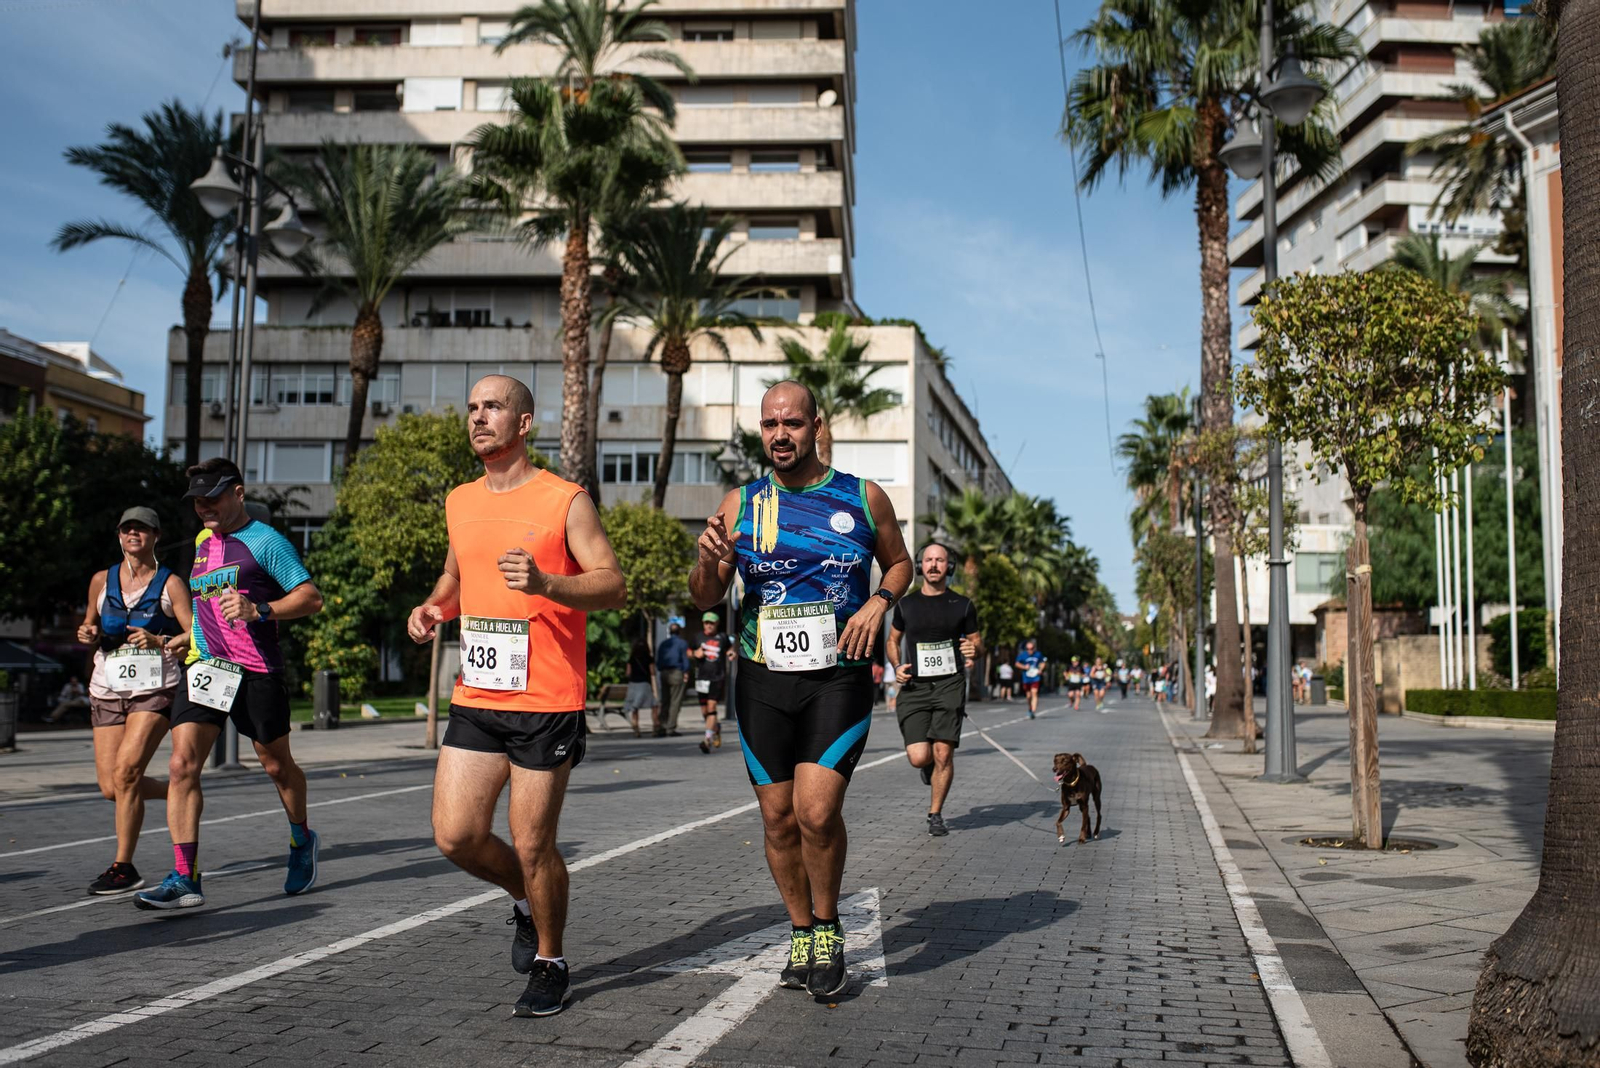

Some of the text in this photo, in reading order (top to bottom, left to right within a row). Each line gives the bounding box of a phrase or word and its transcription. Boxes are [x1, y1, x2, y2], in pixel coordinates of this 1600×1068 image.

[749, 558, 798, 574] aecc
[772, 608, 796, 618] VUELTA
[797, 608, 803, 617] A
[803, 604, 829, 616] HUELVA
[489, 621, 495, 632] A
[495, 622, 523, 633] HUELVA
[774, 630, 810, 654] 430
[467, 645, 497, 670] 438
[924, 655, 943, 667] 598
[118, 663, 137, 679] 26
[192, 672, 212, 692] 52
